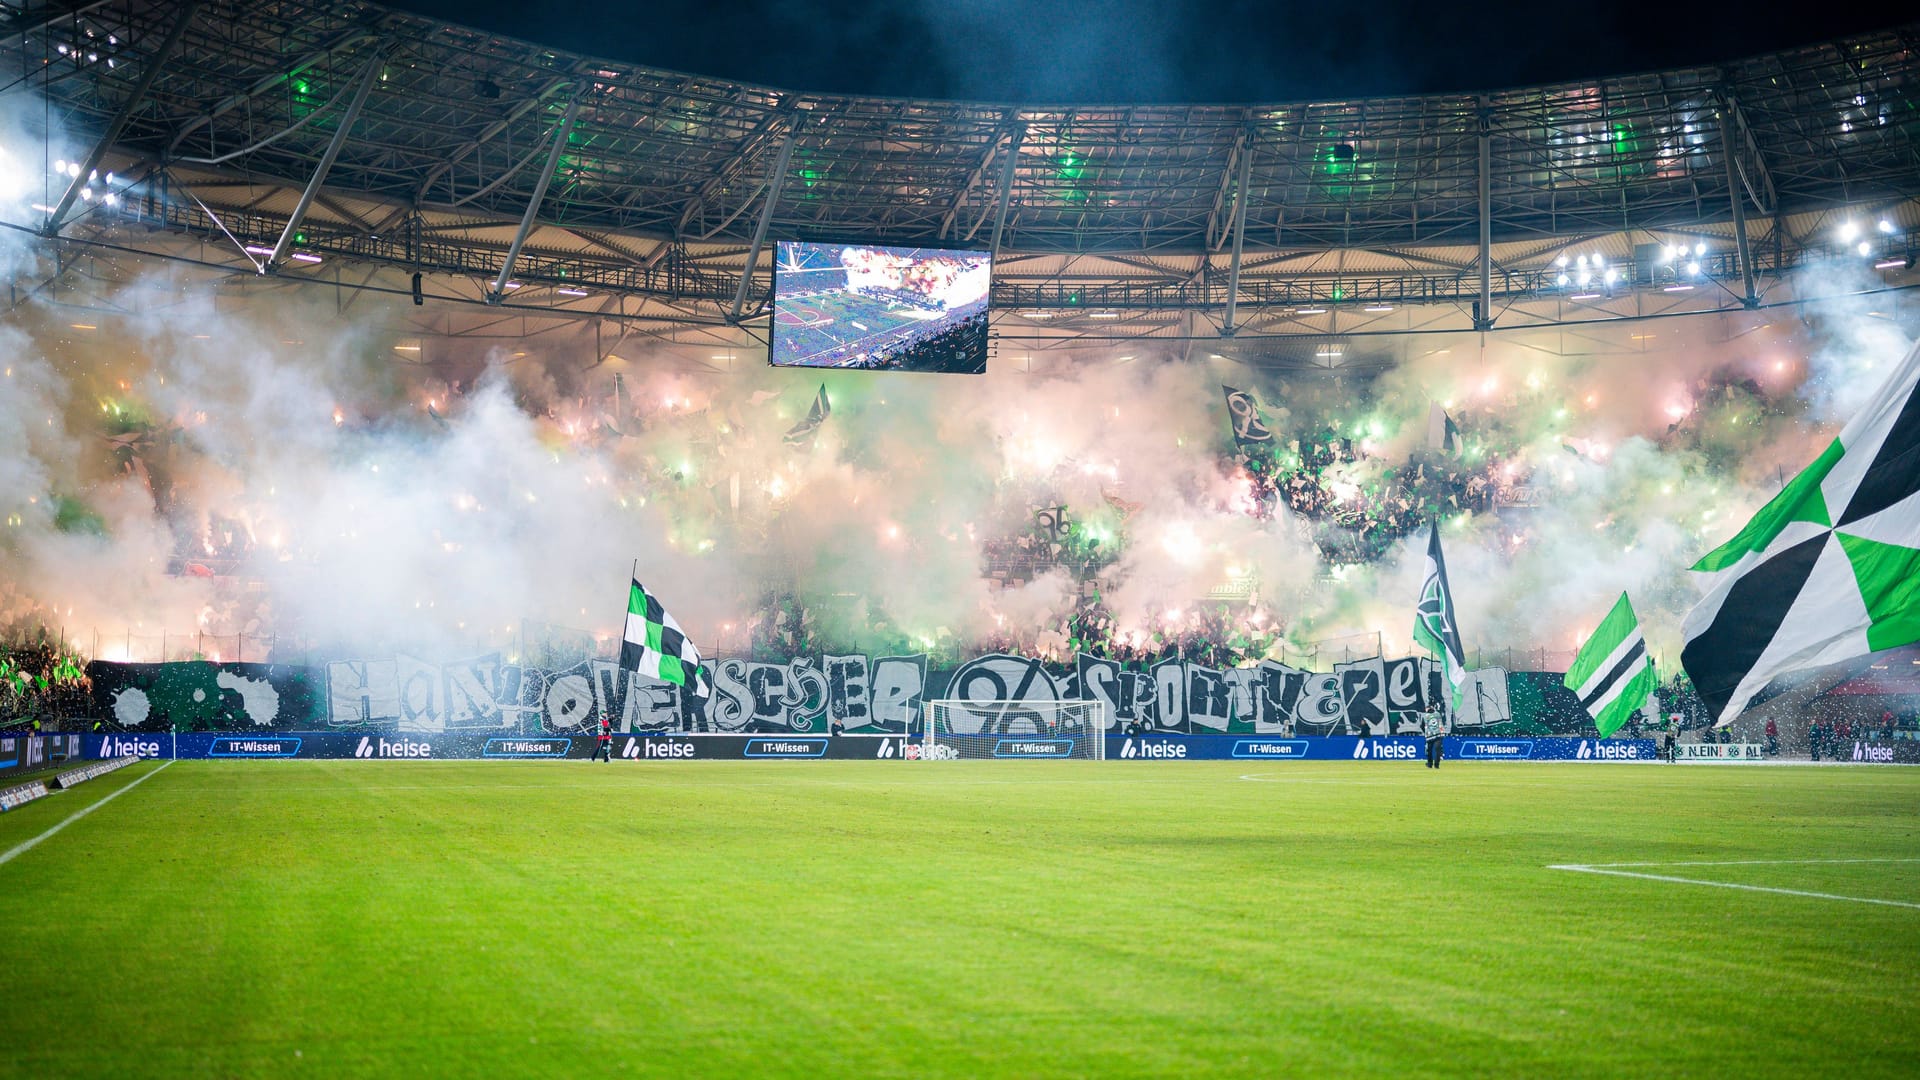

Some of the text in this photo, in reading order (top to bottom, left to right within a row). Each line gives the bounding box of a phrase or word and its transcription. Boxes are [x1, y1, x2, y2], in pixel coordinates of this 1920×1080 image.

[957, 656, 1050, 734] 96
[114, 737, 160, 757] heise
[229, 741, 282, 752] IT-Wissen
[379, 738, 431, 758] heise
[502, 741, 552, 752] IT-Wissen
[644, 737, 695, 758] heise
[762, 742, 810, 753] IT-Wissen
[1011, 742, 1057, 753] IT-Wissen
[1140, 738, 1187, 758] heise
[1248, 743, 1292, 754] IT-Wissen
[1373, 739, 1417, 759] heise
[1475, 743, 1517, 754] IT-Wissen
[1595, 741, 1637, 759] heise
[1864, 742, 1894, 760] heise
